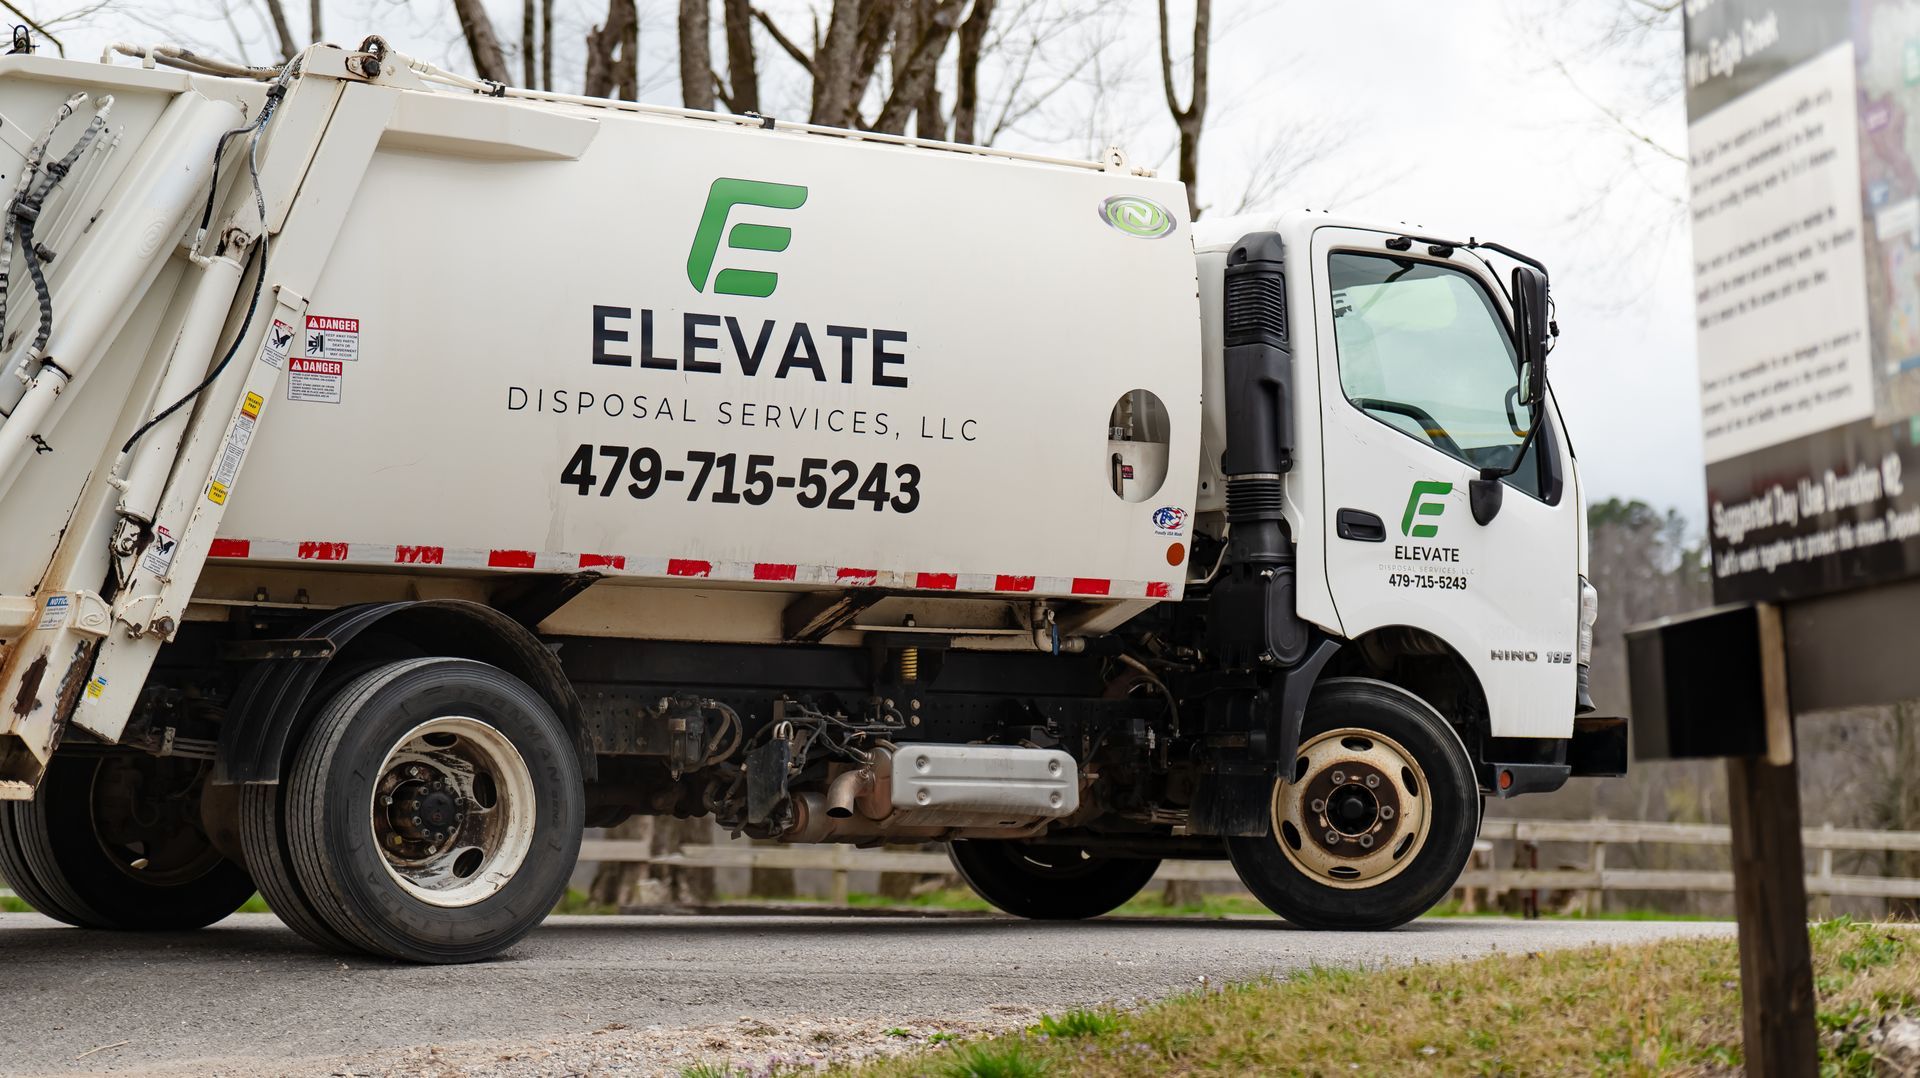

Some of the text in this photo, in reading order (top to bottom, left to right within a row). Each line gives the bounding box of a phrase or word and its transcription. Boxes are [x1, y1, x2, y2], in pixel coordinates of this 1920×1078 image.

[319, 318, 357, 331] DANGER
[592, 304, 908, 388] ELEVATE
[303, 361, 340, 374] DANGER
[507, 386, 978, 441] DISPOSAL SERVICES, LLC
[560, 443, 922, 514] 479-715-5243
[1394, 545, 1460, 562] ELEVATE
[1378, 563, 1416, 572] DISPOSAL
[1461, 567, 1475, 575] LLC
[1388, 573, 1467, 590] 479-715-5243
[1491, 649, 1572, 664] HINO 195
